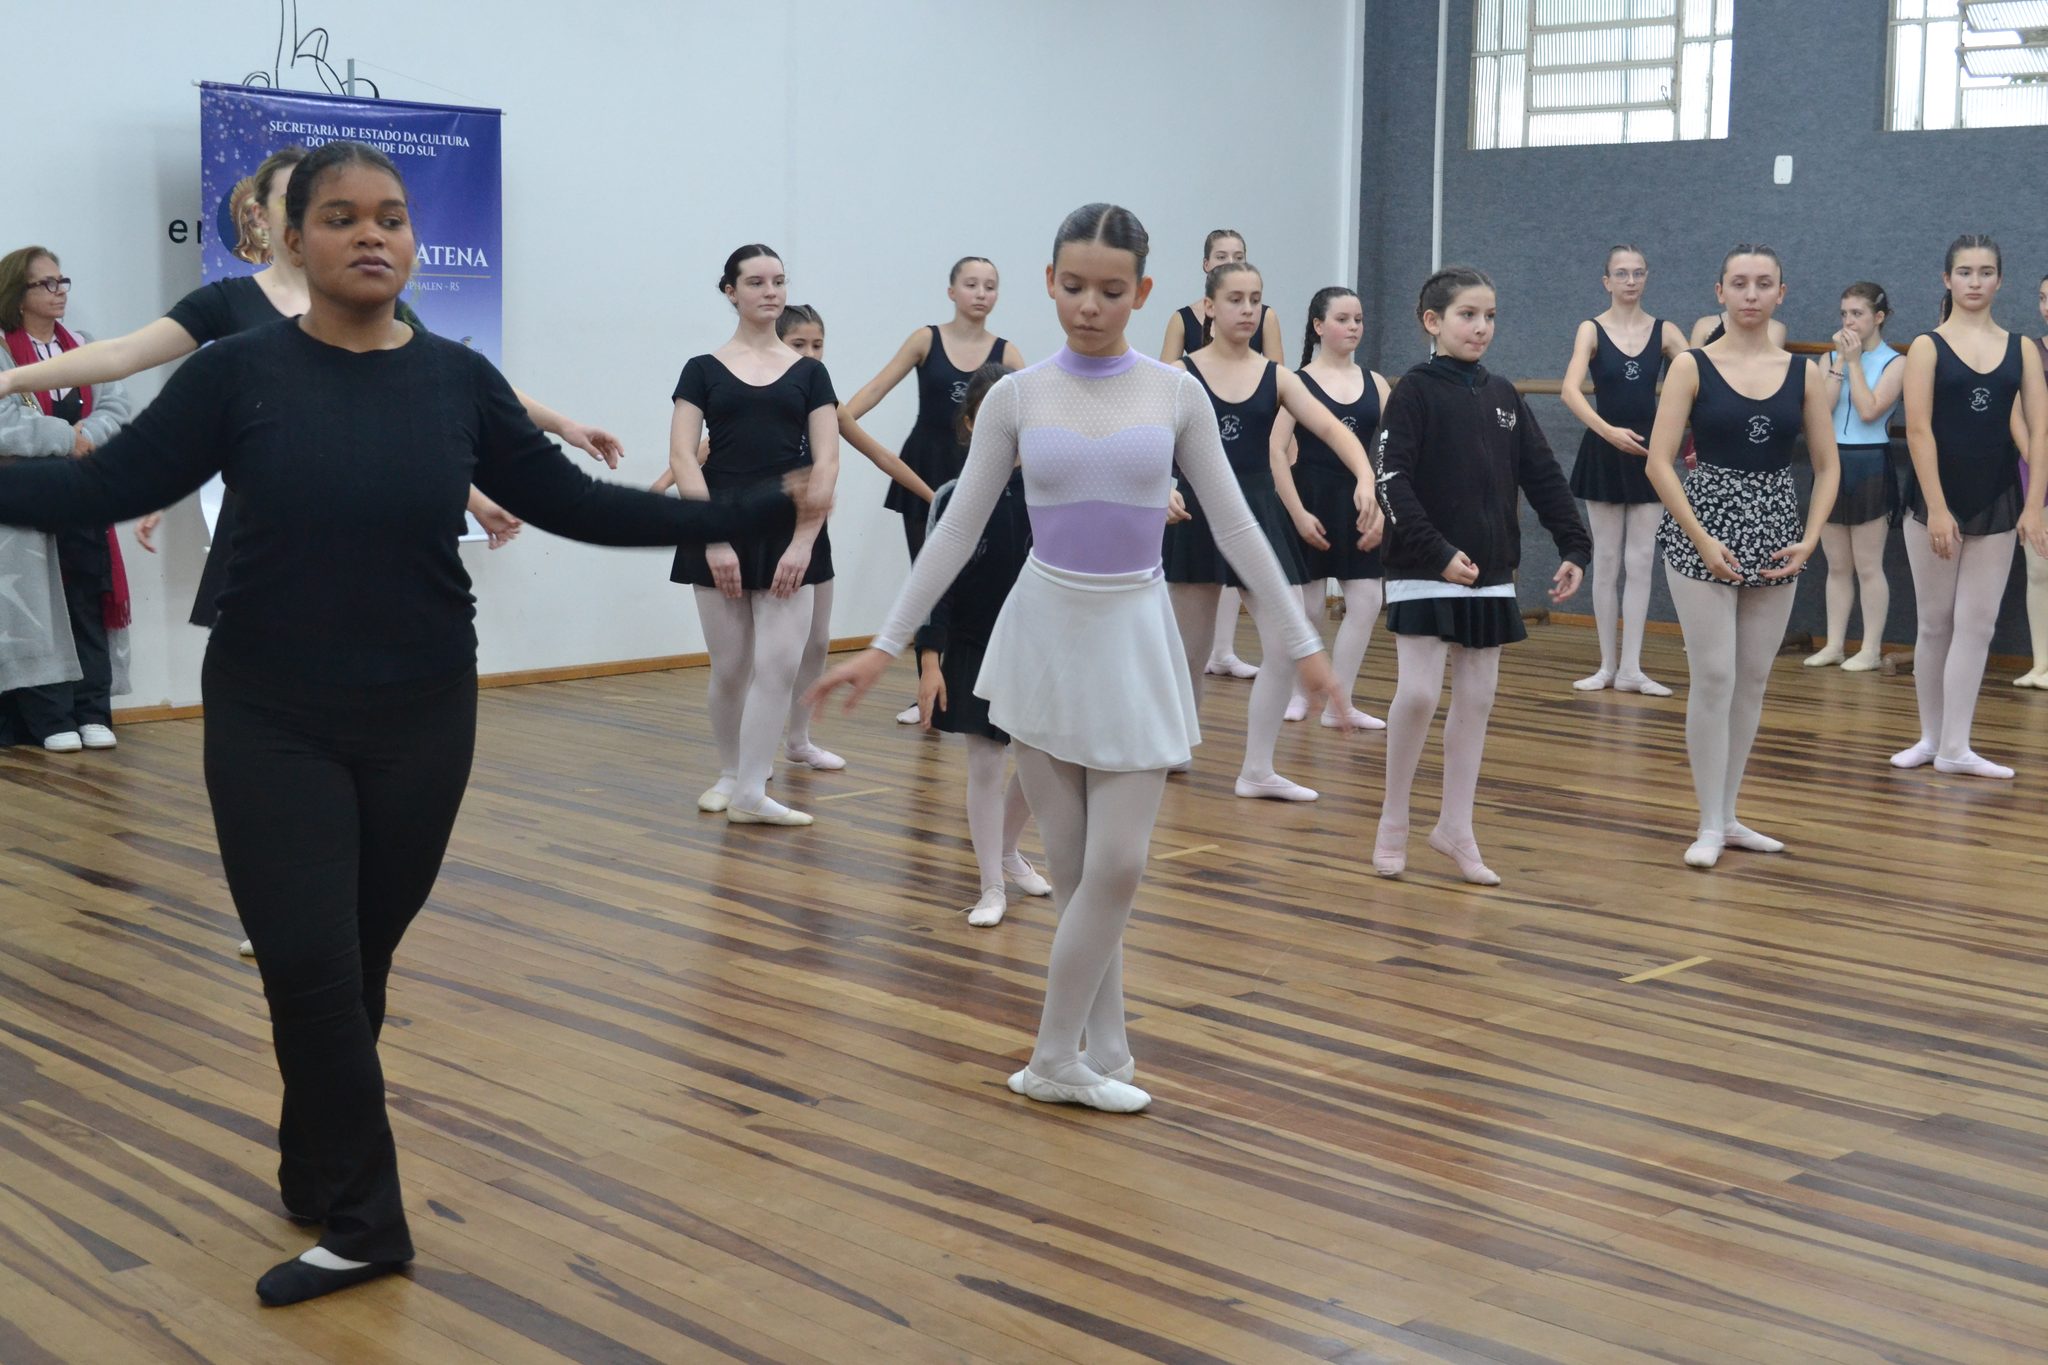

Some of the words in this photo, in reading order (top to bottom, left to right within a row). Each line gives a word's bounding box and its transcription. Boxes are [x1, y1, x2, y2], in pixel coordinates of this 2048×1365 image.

[269, 120, 340, 137] SECRETARIA
[341, 126, 357, 138] DE
[359, 128, 401, 142] ESTADO
[403, 131, 418, 143] DA
[420, 133, 470, 147] CULTURA
[306, 136, 325, 148] DO
[398, 143, 415, 155] DO
[416, 145, 437, 157] SUL
[168, 219, 202, 244] e
[415, 243, 489, 267] ATENA
[450, 282, 460, 292] RS
